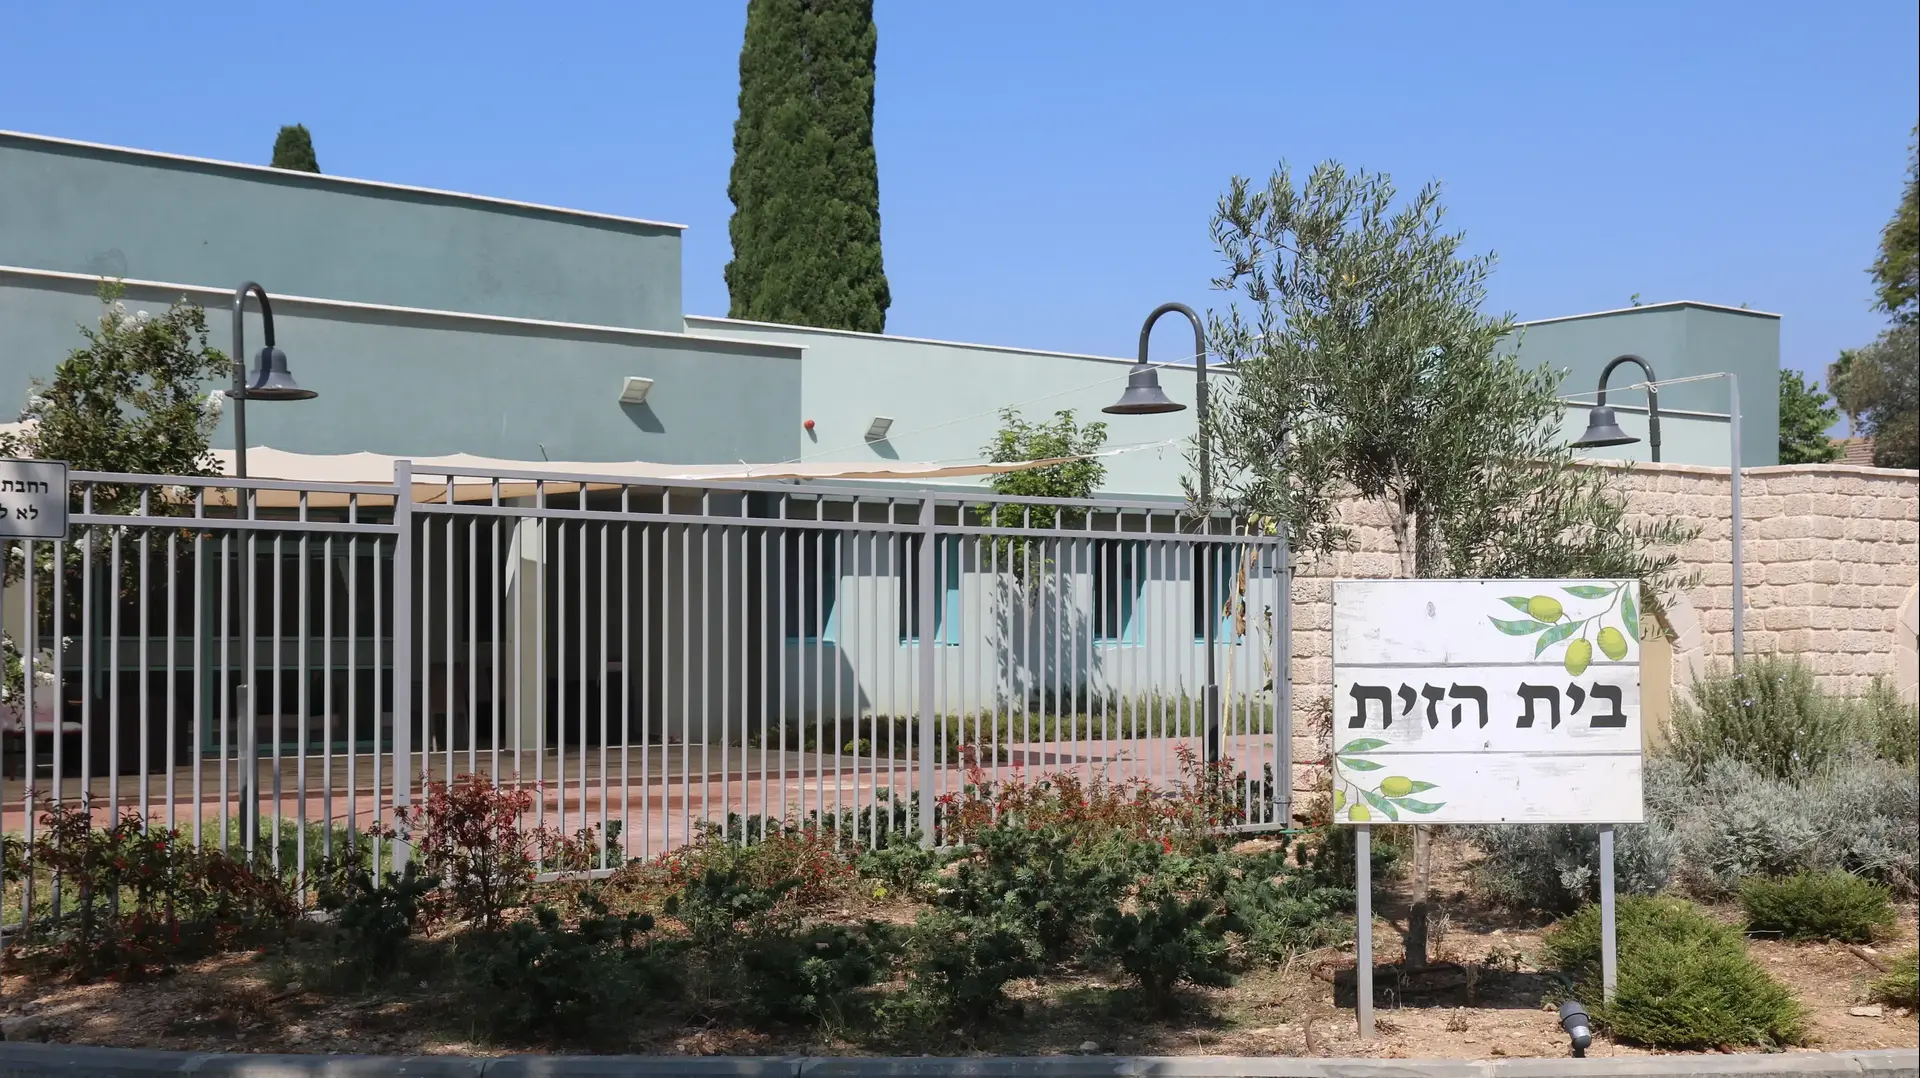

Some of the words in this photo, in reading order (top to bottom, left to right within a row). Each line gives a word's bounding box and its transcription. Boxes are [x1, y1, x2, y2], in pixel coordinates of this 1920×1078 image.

[1, 480, 48, 494] רחבת
[16, 504, 39, 520] לא
[1348, 681, 1489, 730] הזית
[1516, 681, 1628, 730] בית
